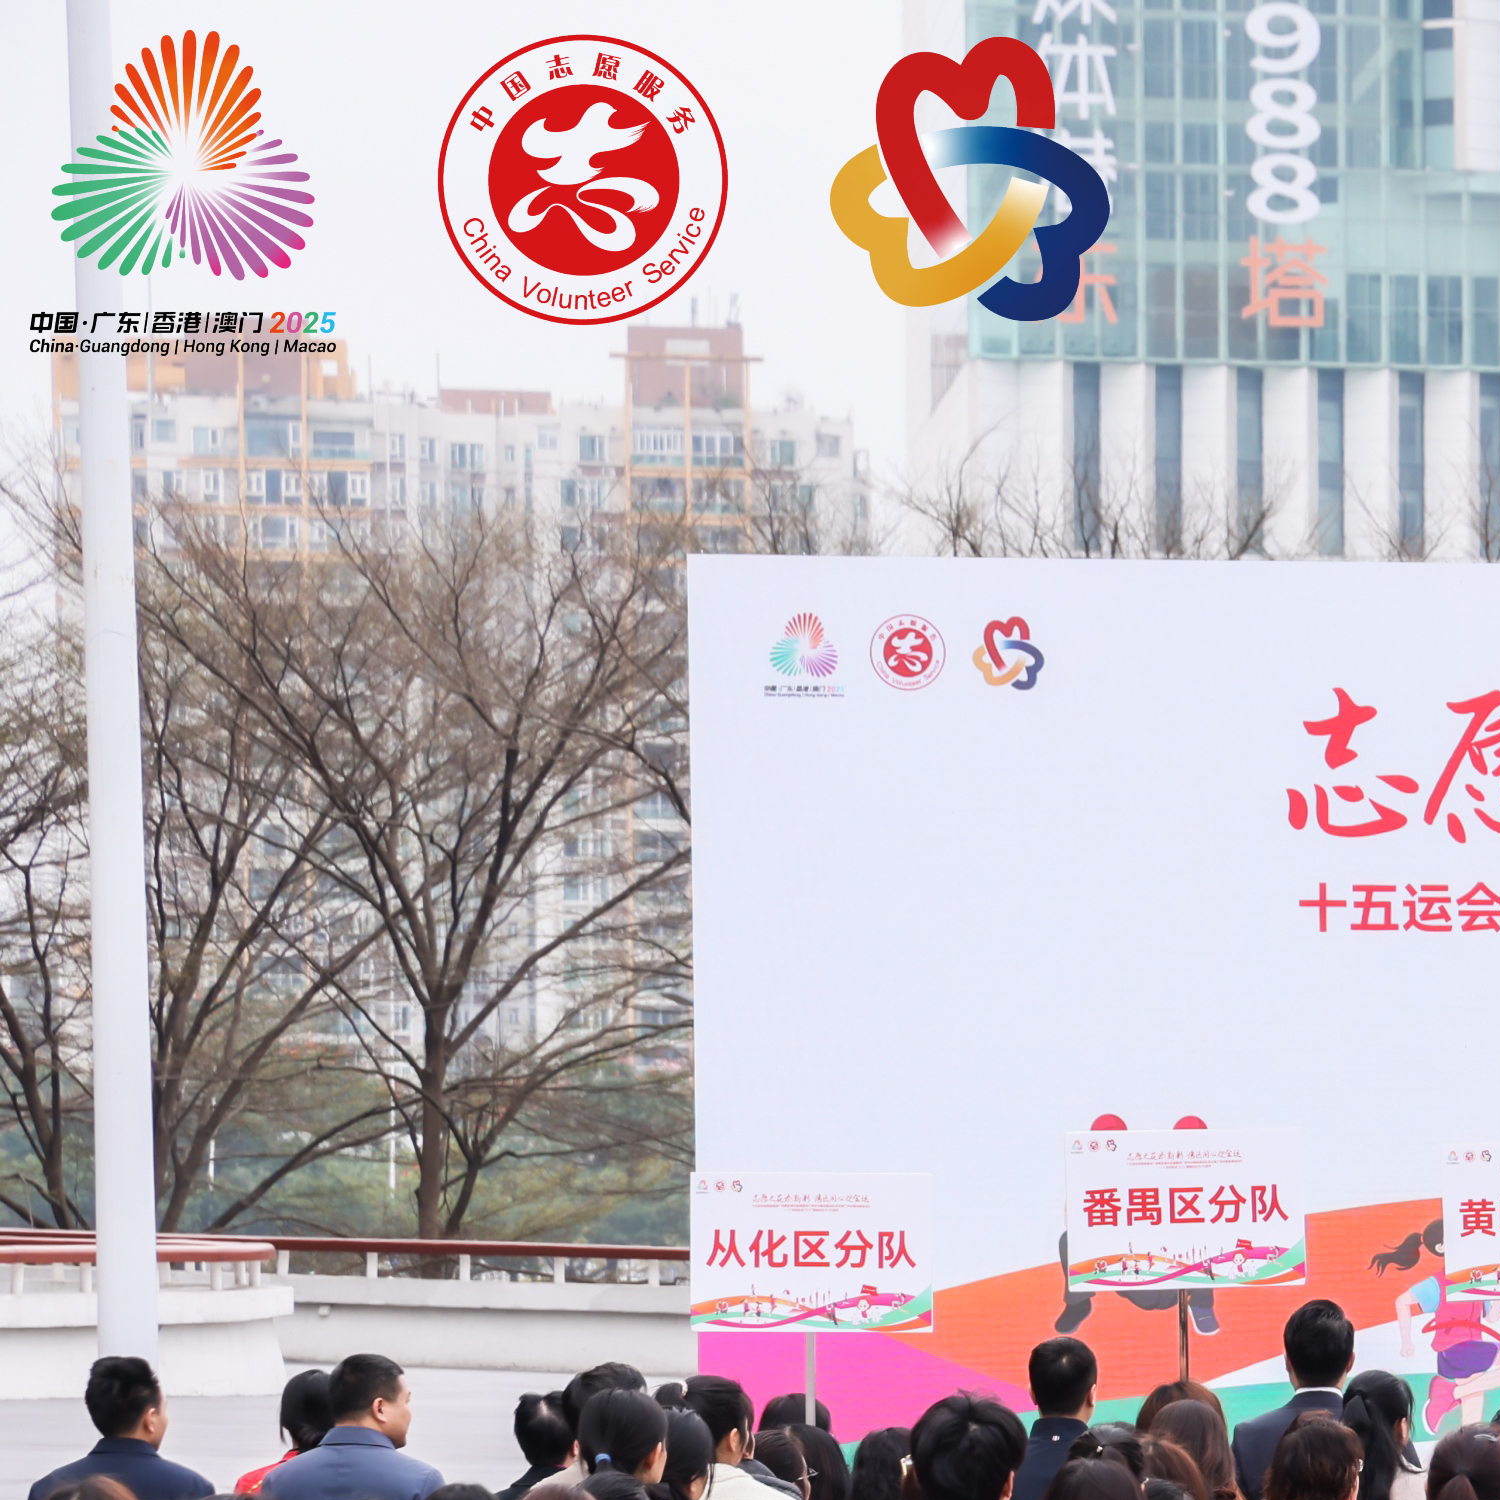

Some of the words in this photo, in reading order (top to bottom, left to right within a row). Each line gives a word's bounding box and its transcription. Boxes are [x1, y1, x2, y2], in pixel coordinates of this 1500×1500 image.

[1083, 1183, 1289, 1227] 番禺区分队
[706, 1229, 917, 1269] 从化区分队
